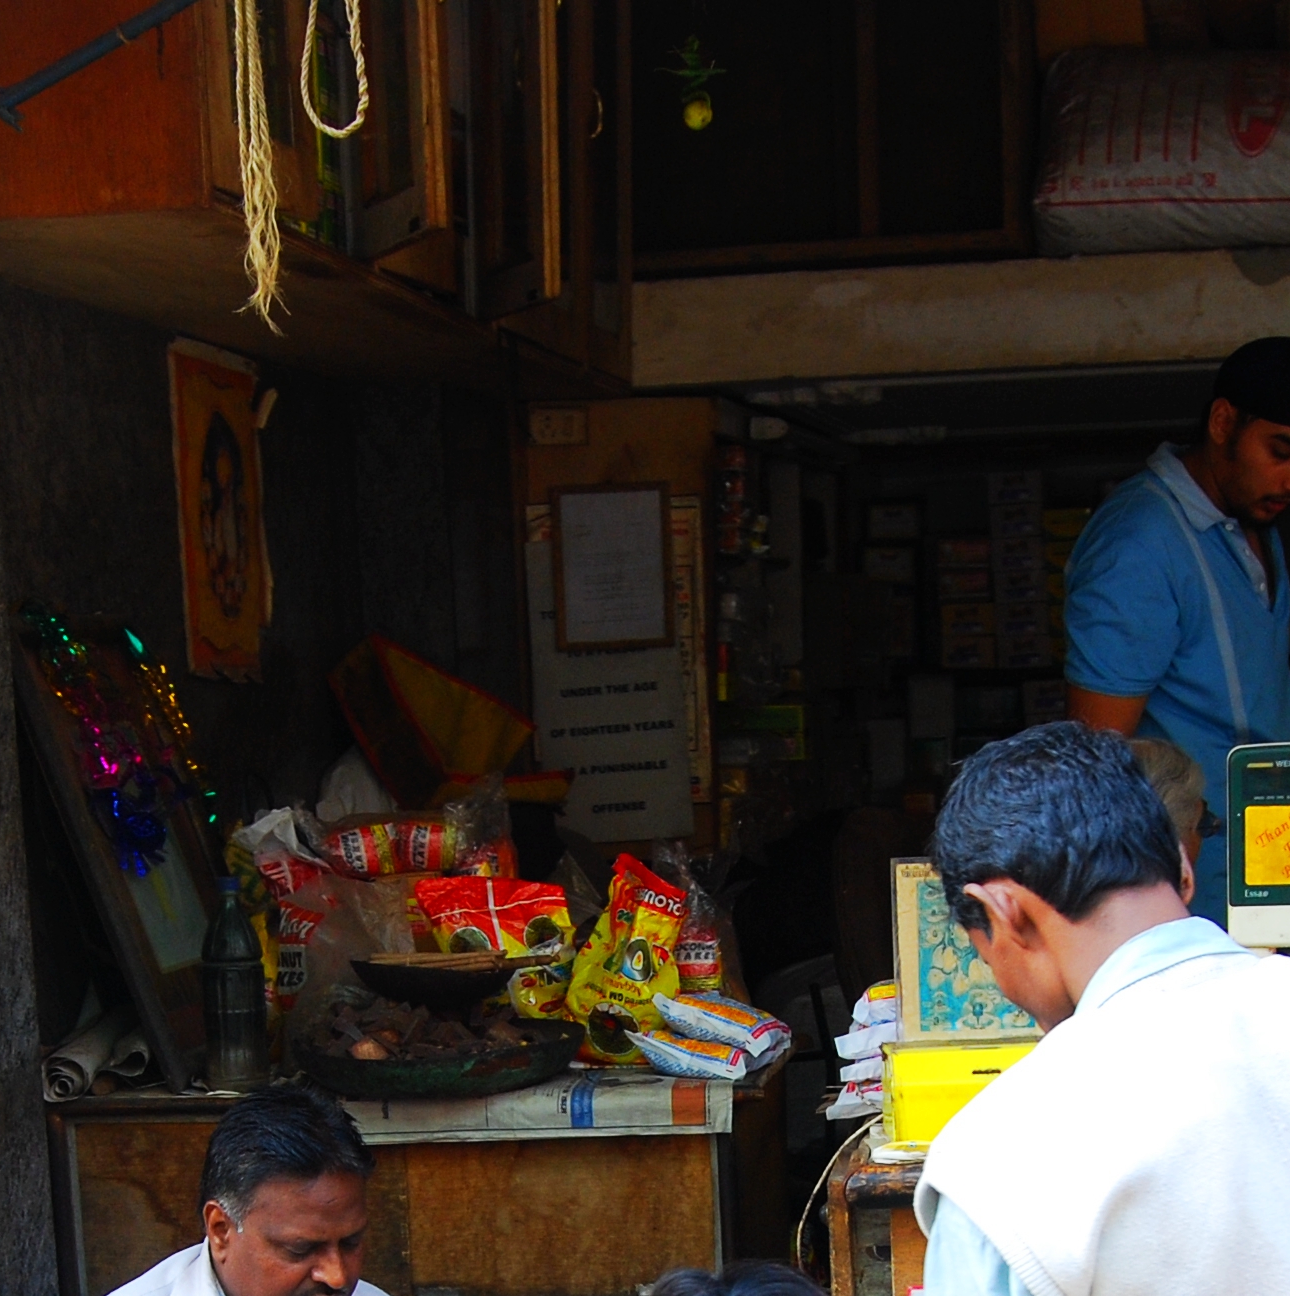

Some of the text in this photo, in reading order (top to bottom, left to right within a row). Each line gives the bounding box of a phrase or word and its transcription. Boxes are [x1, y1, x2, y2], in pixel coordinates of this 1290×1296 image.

[560, 681, 658, 699] UNDER THE AGE
[550, 719, 676, 739] OF EIGHTEEN YEARS
[579, 759, 668, 776] A PUNISHABLE
[592, 801, 647, 814] OFFENSE
